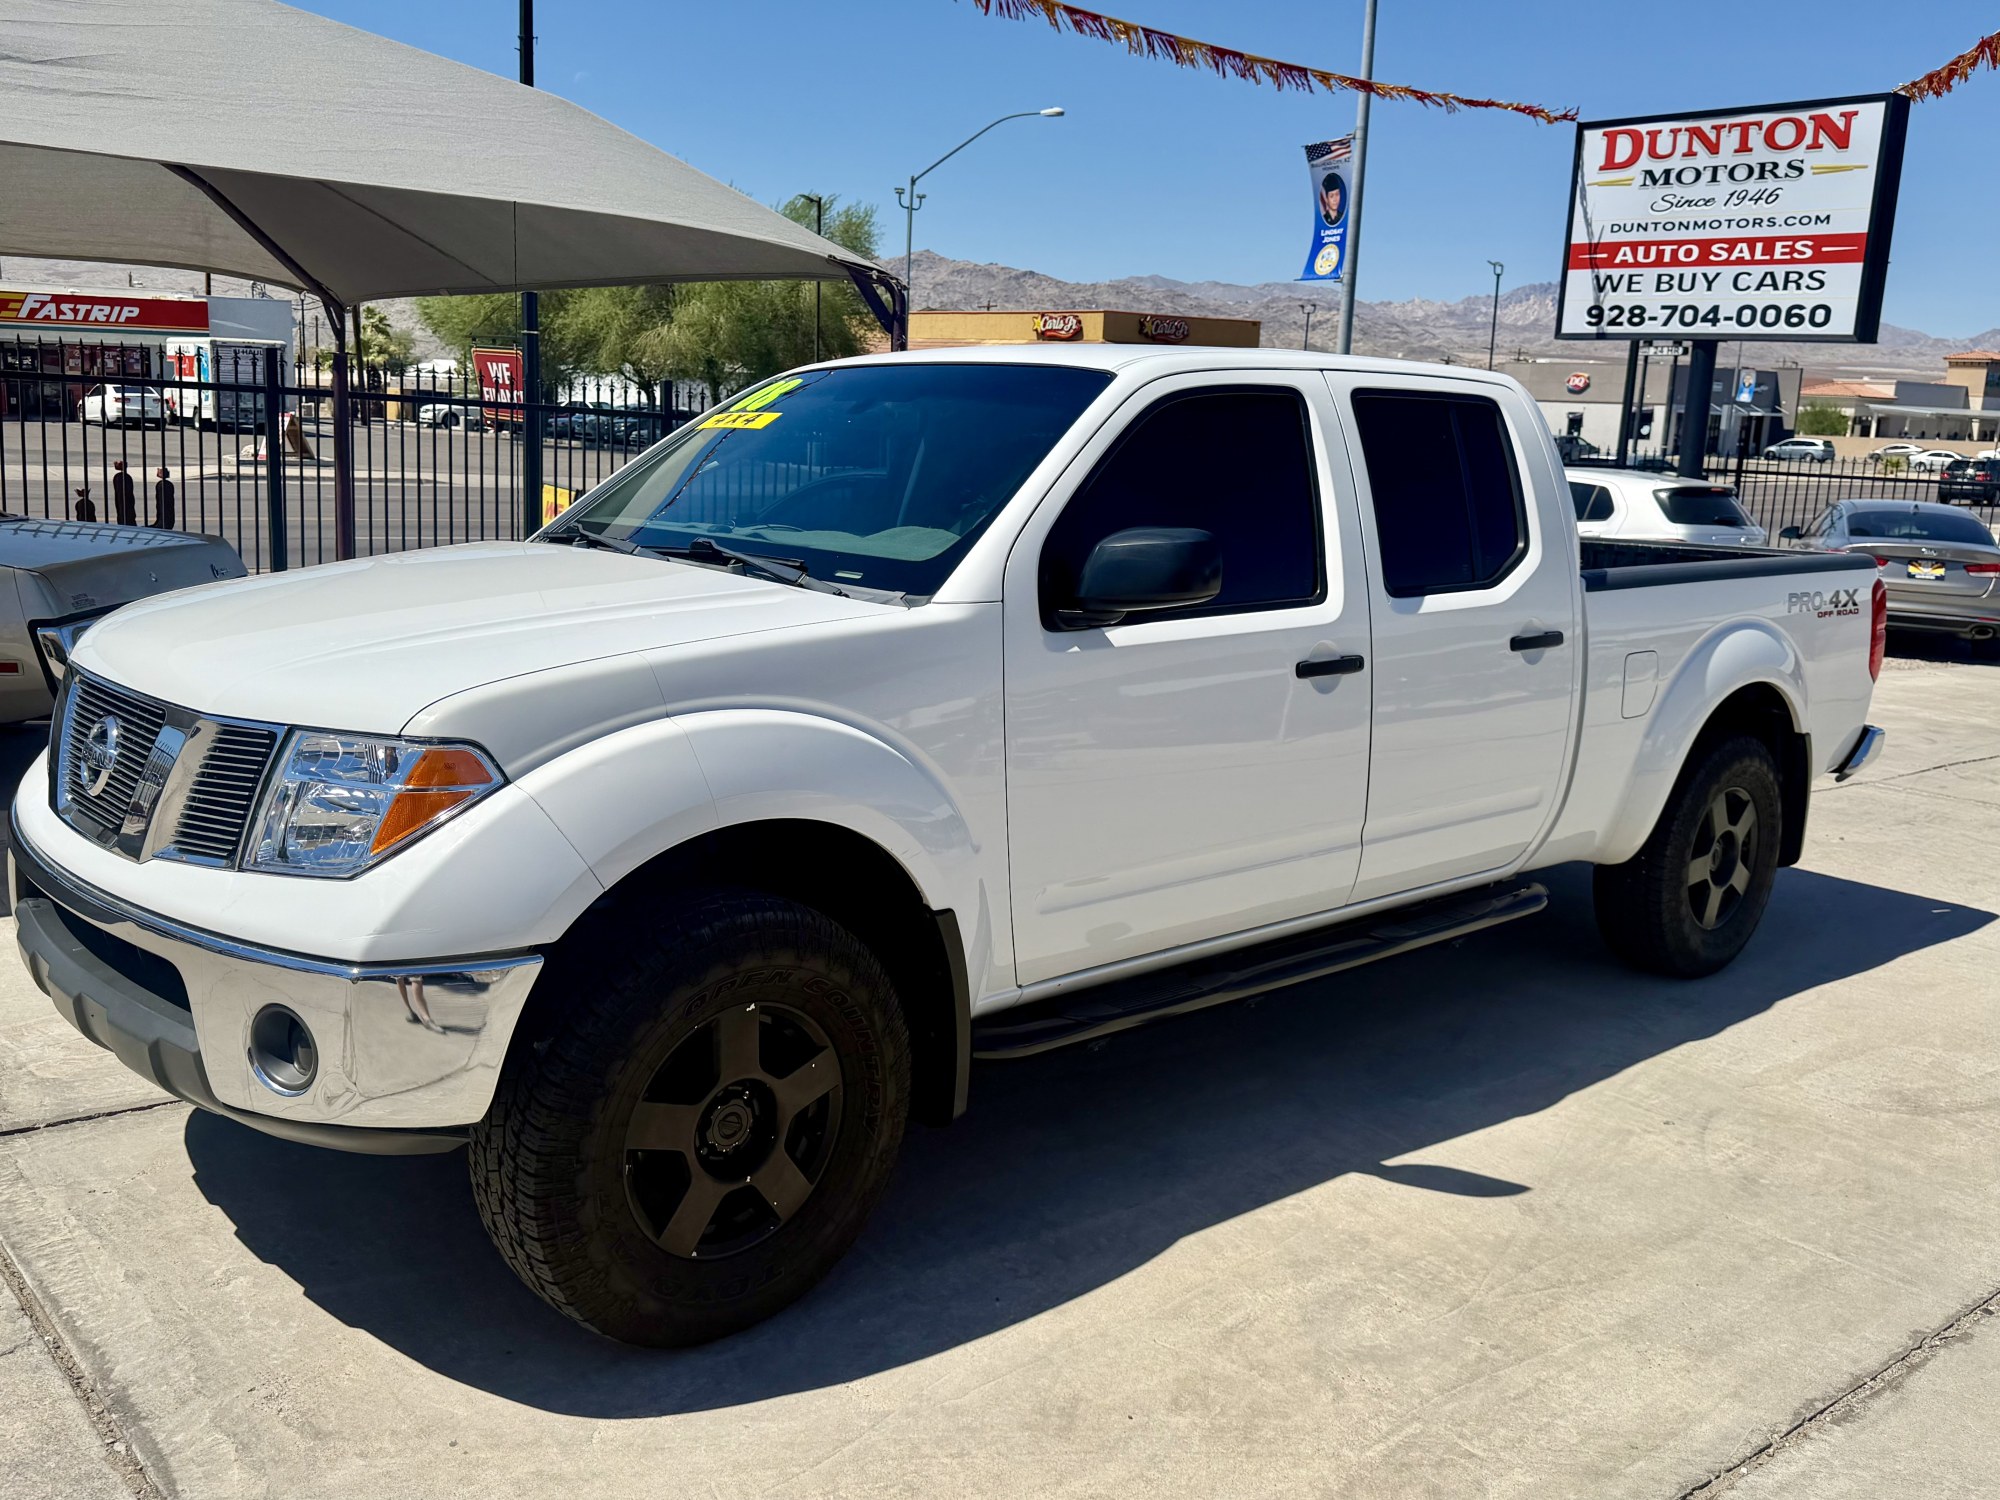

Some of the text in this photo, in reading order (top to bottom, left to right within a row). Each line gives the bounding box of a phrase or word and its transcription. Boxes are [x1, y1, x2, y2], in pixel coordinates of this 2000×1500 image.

[1598, 110, 1859, 171] DUNTON
[1640, 159, 1804, 187] MOTORS
[1650, 188, 1783, 212] Since 1946
[1610, 214, 1831, 233] DUNTONMOTORS.COM
[1614, 240, 1814, 264] AUTO SALES
[1597, 270, 1827, 293] WE BUY CARS
[17, 294, 140, 322] FASTRIP
[1585, 304, 1832, 328] 928-704-0060
[487, 362, 511, 385] WE
[1569, 376, 1586, 388] DQ
[1817, 608, 1859, 618] OFF ROAD
[684, 968, 796, 1018] OPEN
